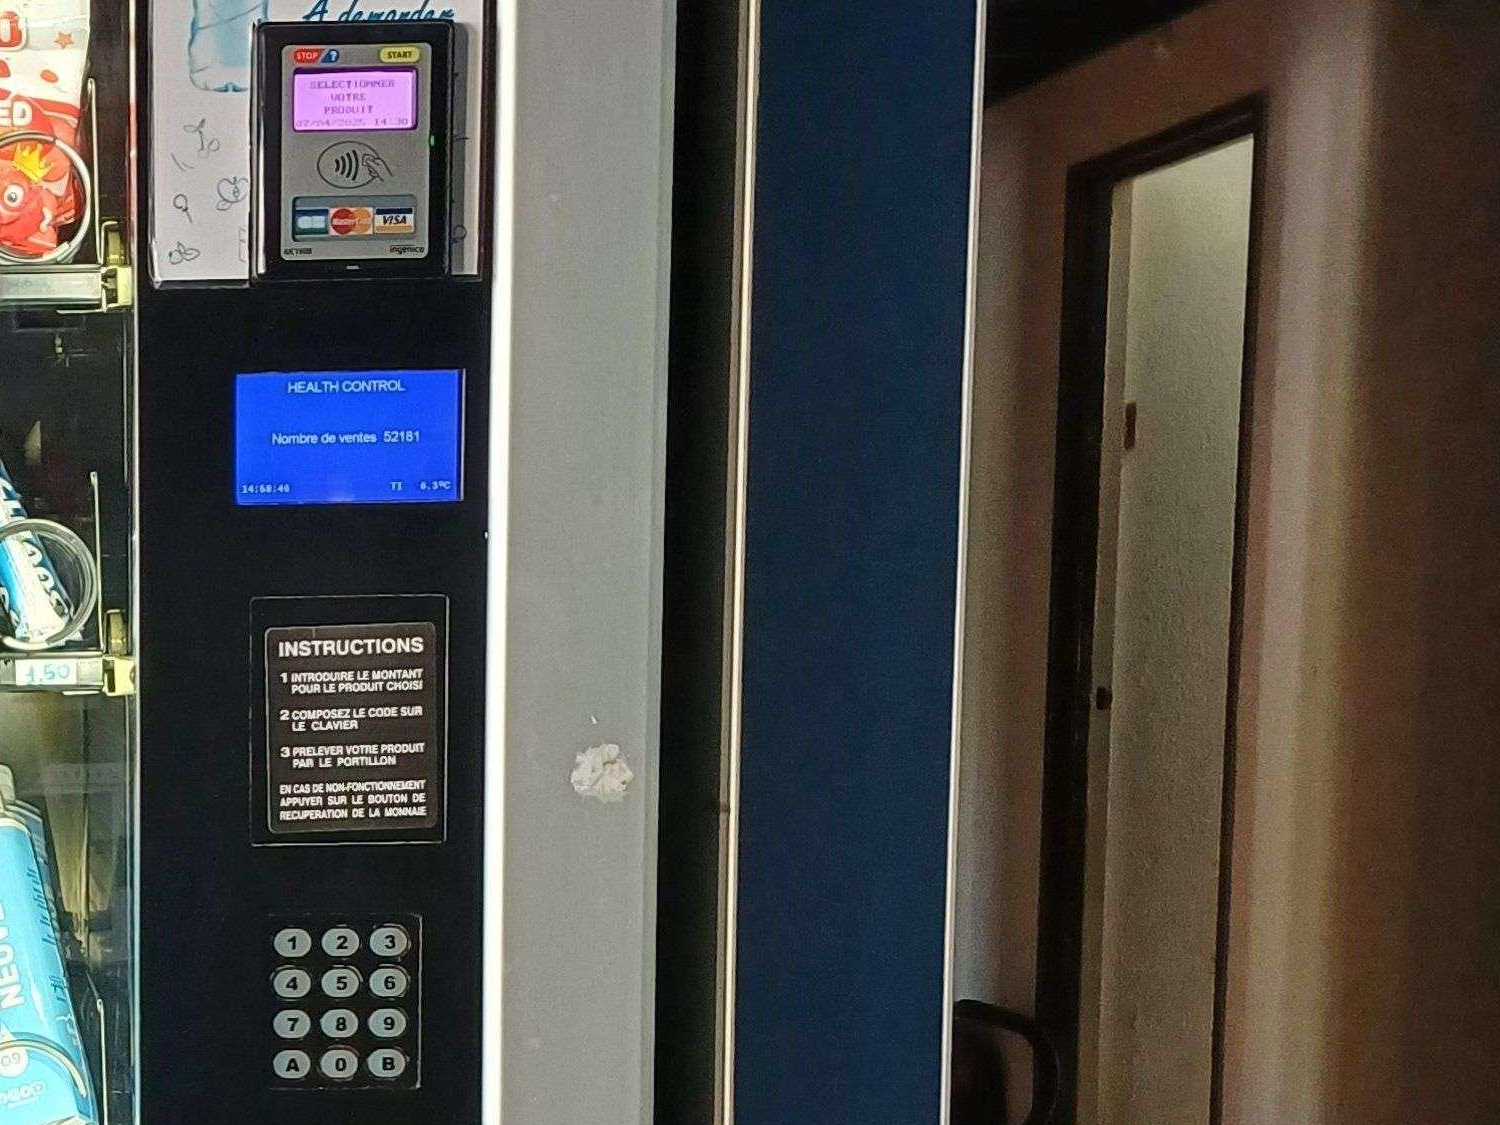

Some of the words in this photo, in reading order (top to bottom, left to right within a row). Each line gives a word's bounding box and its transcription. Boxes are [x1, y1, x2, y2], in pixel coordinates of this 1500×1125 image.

[296, 50, 317, 60] STOP
[388, 50, 412, 59] START
[330, 93, 366, 101] VOTRE
[324, 105, 373, 115] PRODUIT
[383, 215, 407, 225] VISA
[287, 381, 339, 394] HEALTH
[342, 379, 405, 393] CONTROL
[272, 432, 318, 445] Nombre
[321, 432, 336, 444] de
[339, 433, 377, 444] ventes
[383, 431, 420, 443] 52181
[278, 637, 424, 657] INSTRUCTIONS
[280, 673, 288, 683] 1
[291, 671, 354, 683] INTRODUIRE
[357, 671, 369, 681] LE
[372, 668, 423, 680] MONTANT
[291, 683, 321, 694] POUR
[323, 682, 336, 693] LE
[338, 681, 383, 692] PRODUIT
[386, 680, 423, 691] CHOISI
[280, 710, 289, 721] 2
[291, 709, 350, 720] COMPOSEZ
[352, 708, 366, 718] LE
[368, 707, 398, 717] CODE
[400, 706, 423, 717] SUR
[291, 721, 306, 732] LE
[311, 720, 358, 731] CLAVIER
[280, 747, 290, 758] 3
[292, 746, 343, 757] PRELEVER
[345, 744, 379, 755] VOTRE
[381, 743, 425, 754] PRODUIT
[292, 757, 313, 769] PAR
[319, 757, 332, 768] LE
[337, 755, 397, 767] PORTILLON
[279, 784, 292, 795] EN
[293, 783, 311, 794] CAS
[312, 783, 324, 793] DE
[326, 780, 426, 793] NON-FONCTIONNEMENT
[280, 795, 323, 807] APPUYER
[328, 795, 347, 805] SUR
[351, 795, 363, 805] LE
[368, 793, 407, 804] BOUTON
[412, 793, 426, 803] DE
[279, 808, 348, 821] RECUPERATION
[352, 807, 365, 818] DE
[368, 807, 381, 818] LA
[384, 806, 427, 817] MONNAIE
[287, 936, 297, 950] 1
[336, 935, 348, 950] 2
[384, 935, 396, 949] 3
[286, 976, 298, 990] 4
[336, 976, 347, 990] 5
[384, 975, 396, 990] 6
[287, 1017, 298, 1031] 7
[335, 1016, 347, 1031] 8
[383, 1016, 395, 1030] 9
[286, 1058, 300, 1072] A
[335, 1058, 346, 1072] 0
[382, 1057, 394, 1071] B
